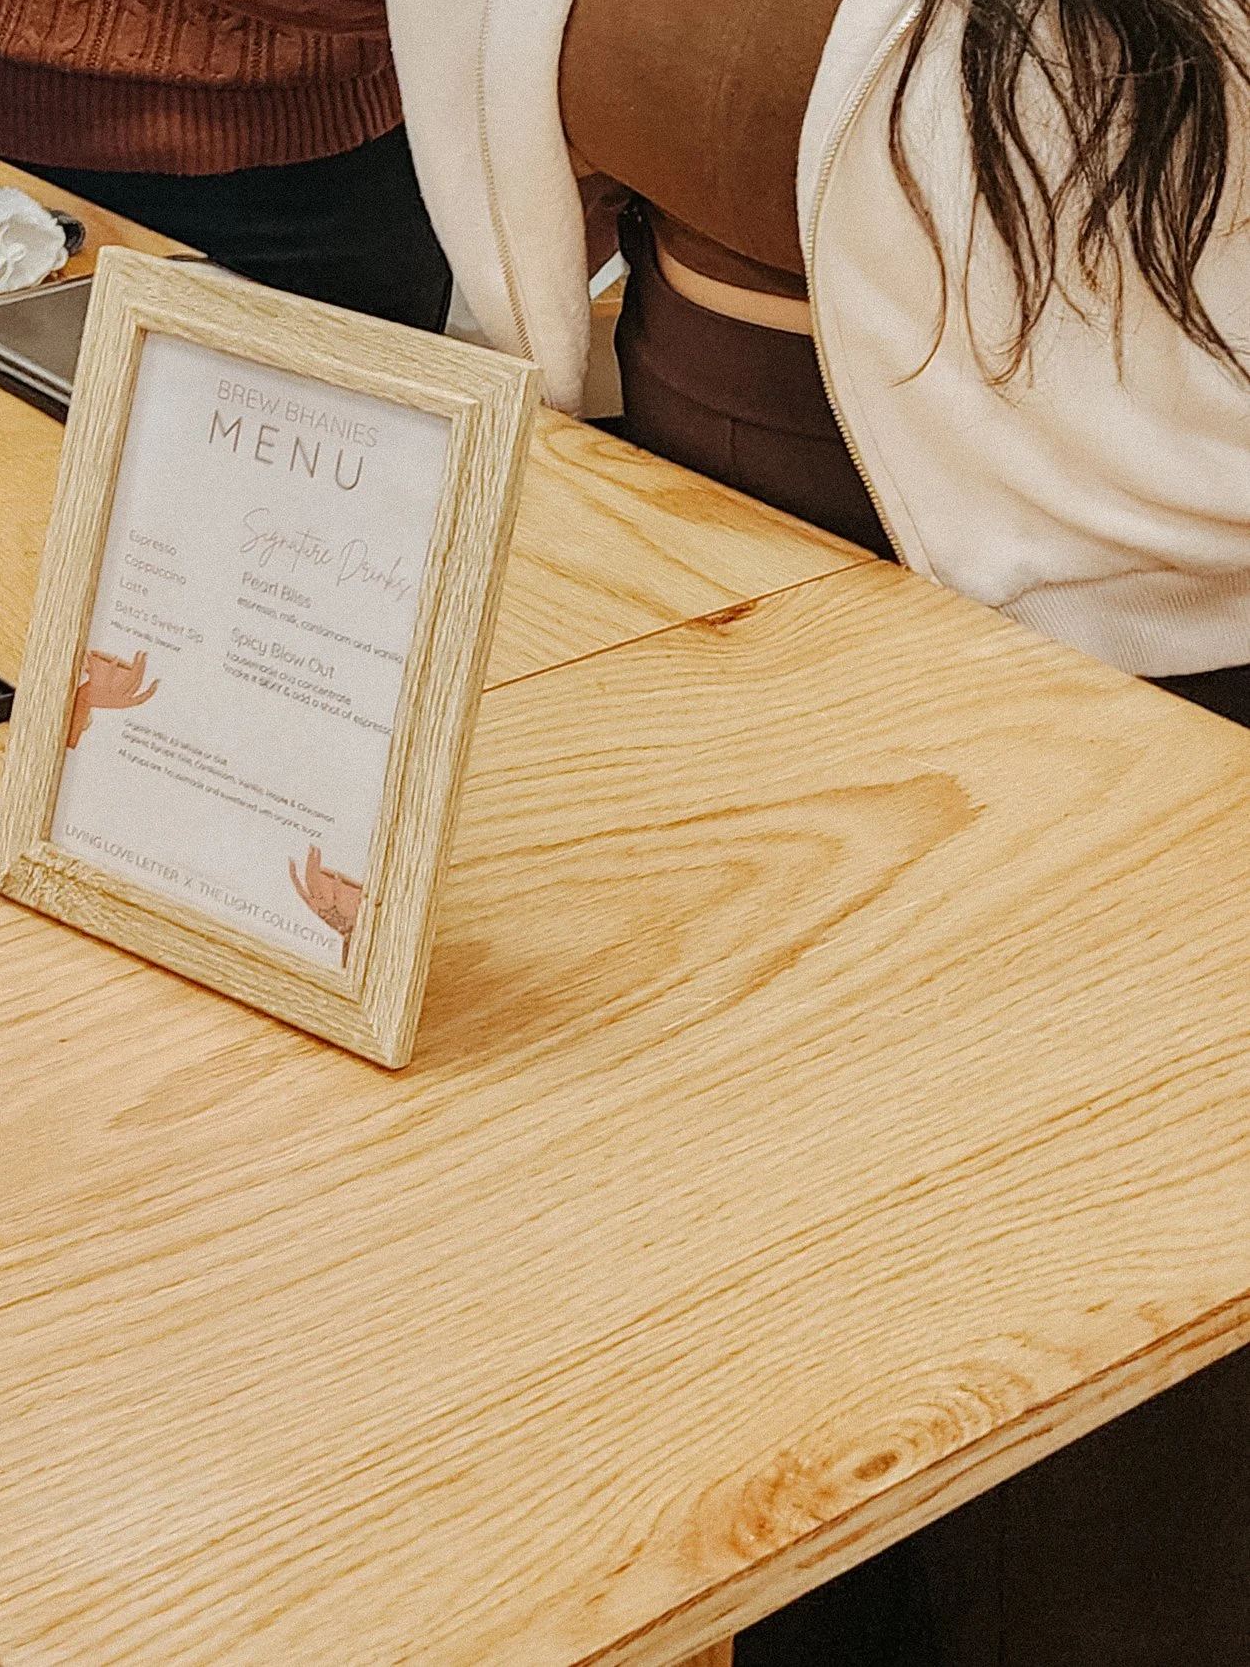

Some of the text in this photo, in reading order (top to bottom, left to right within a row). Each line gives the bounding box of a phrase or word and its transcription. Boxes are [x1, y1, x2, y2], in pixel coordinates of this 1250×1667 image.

[217, 379, 280, 415] BREW
[209, 409, 364, 491] MENU
[241, 570, 278, 596] Pearl
[231, 626, 267, 656] Spicy
[307, 656, 335, 679] Out
[65, 823, 101, 849] LIVING
[103, 840, 133, 863] LOVE
[183, 876, 192, 888] X
